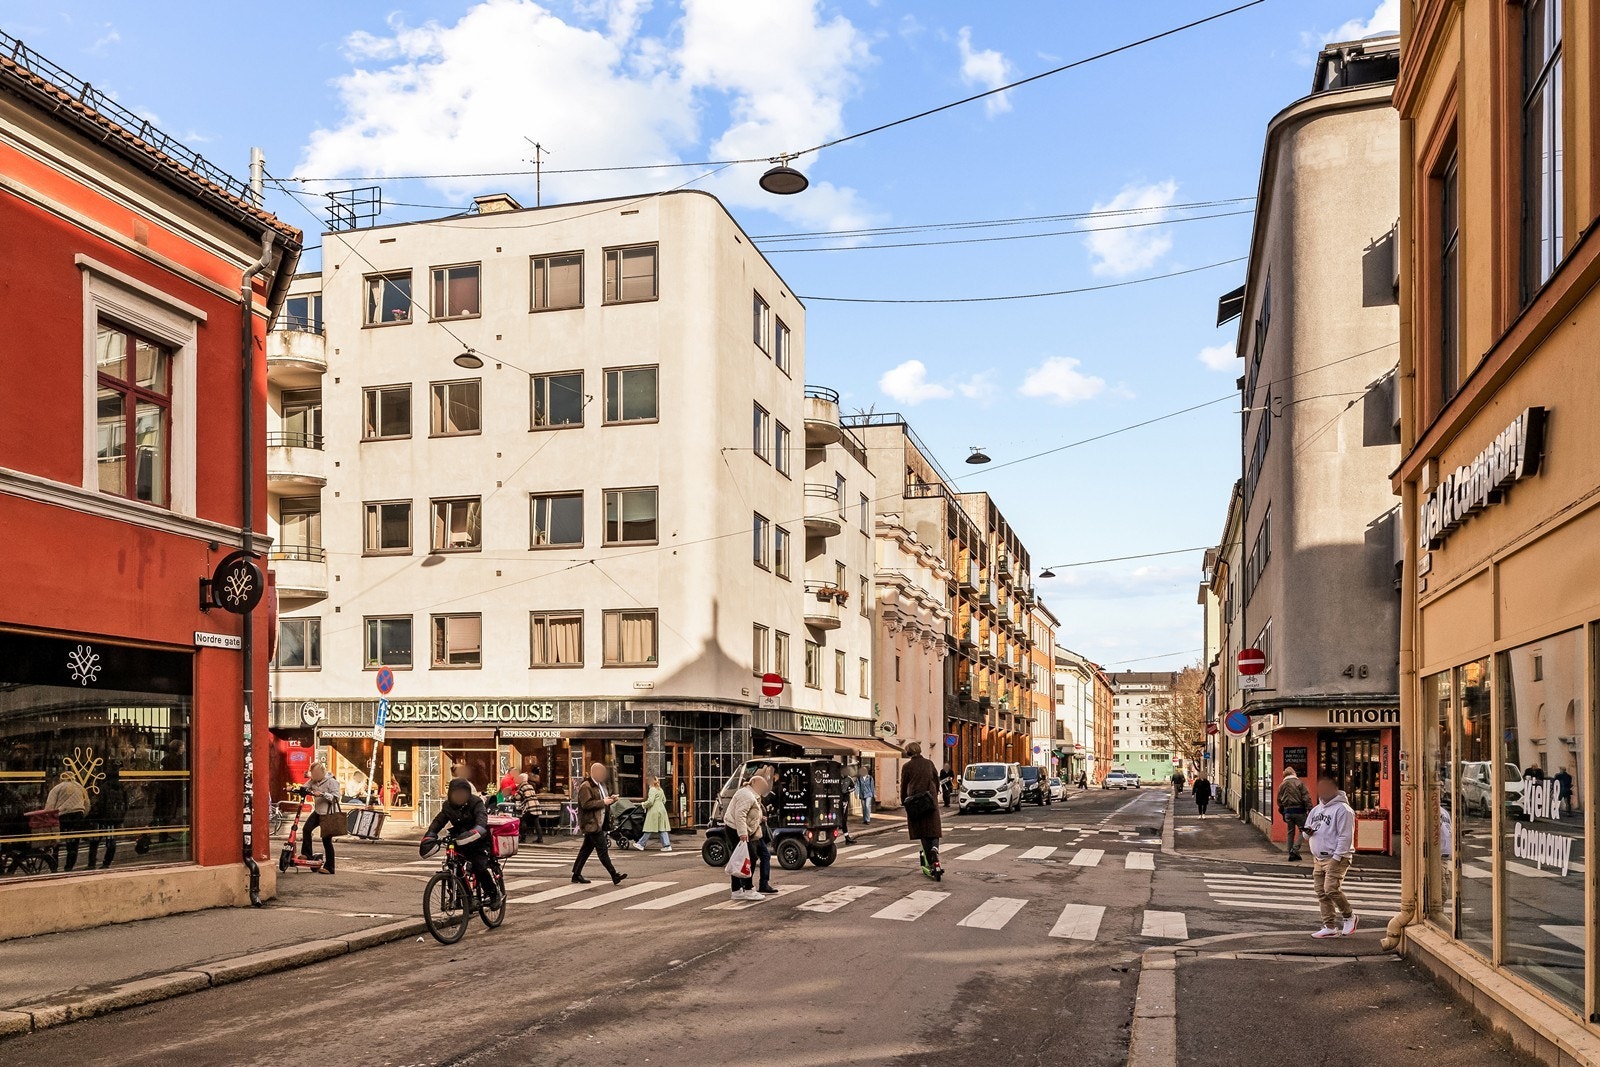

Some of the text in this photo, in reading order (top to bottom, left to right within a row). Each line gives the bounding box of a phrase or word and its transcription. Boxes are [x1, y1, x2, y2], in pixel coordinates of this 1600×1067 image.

[196, 633, 241, 646] Nordre gate
[1342, 663, 1369, 679] 48
[482, 703, 554, 722] HOUSE
[803, 715, 845, 734] ESPRESSO HOUSE
[322, 730, 353, 738] ESPRESSO
[783, 768, 794, 777] THE
[782, 787, 807, 799] COMPANY
[1523, 776, 1561, 823] Kjell &
[1514, 821, 1572, 877] Company
